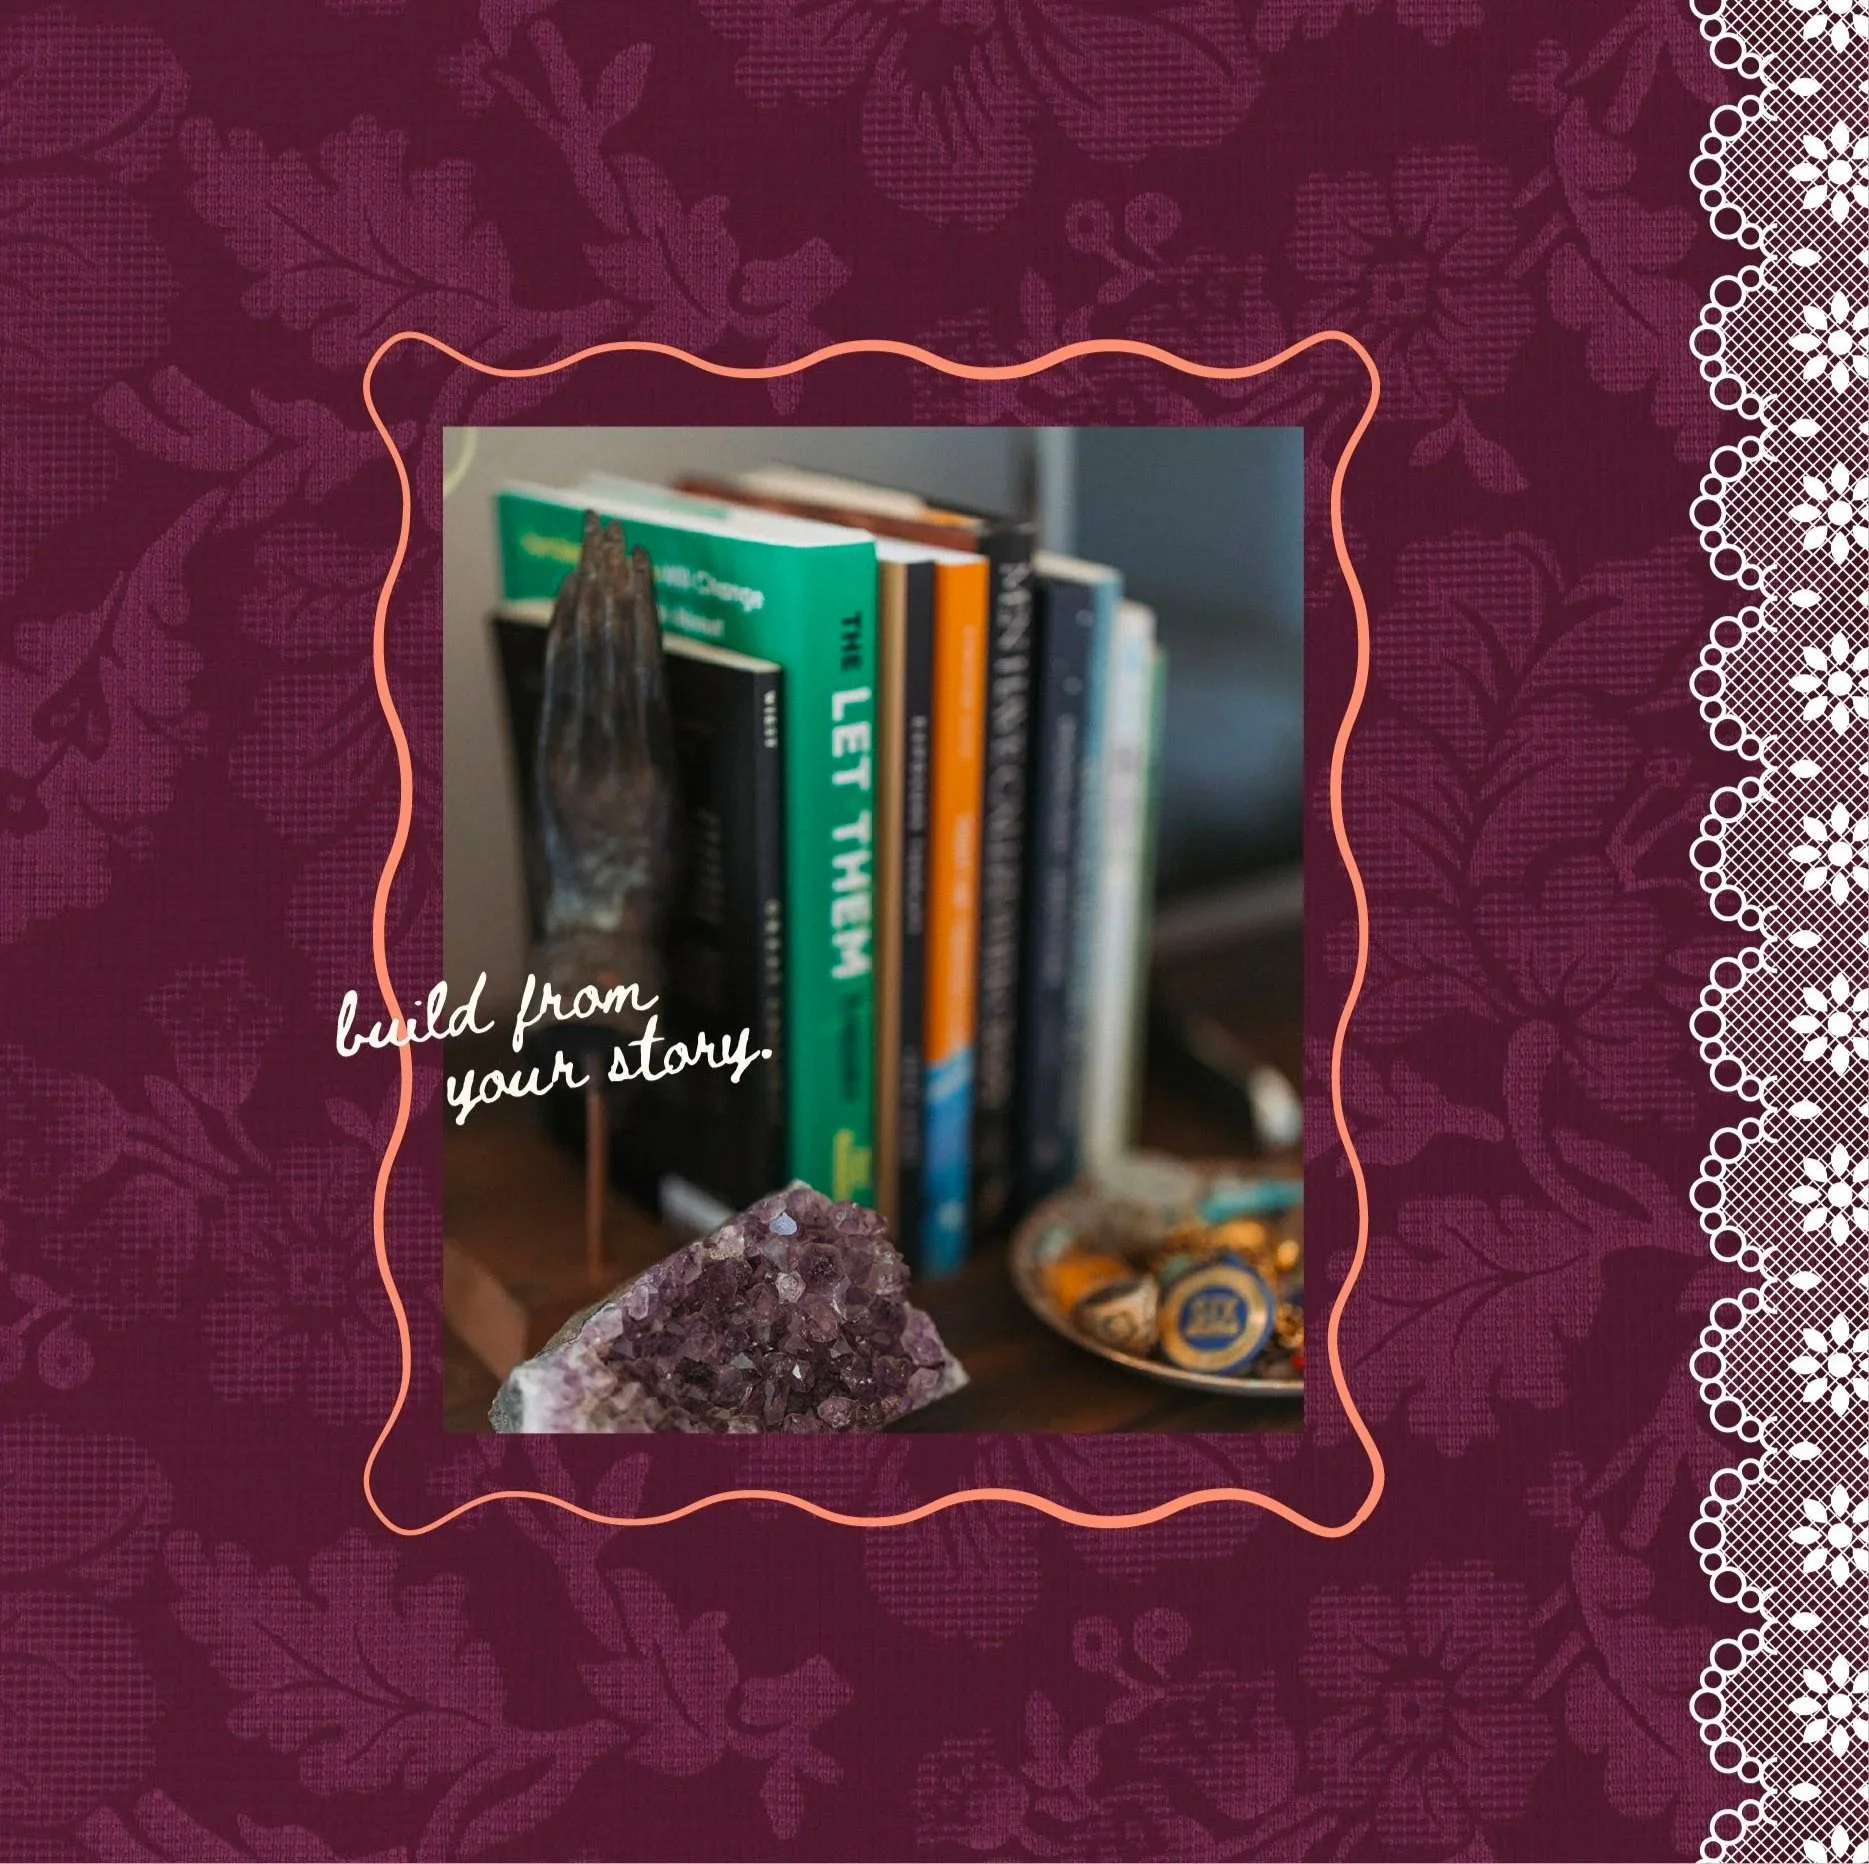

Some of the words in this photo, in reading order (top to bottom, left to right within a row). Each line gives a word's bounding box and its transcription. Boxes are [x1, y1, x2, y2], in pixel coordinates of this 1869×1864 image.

[840, 612, 863, 672] THE
[831, 687, 872, 790] LET
[831, 812, 872, 979] THEM
